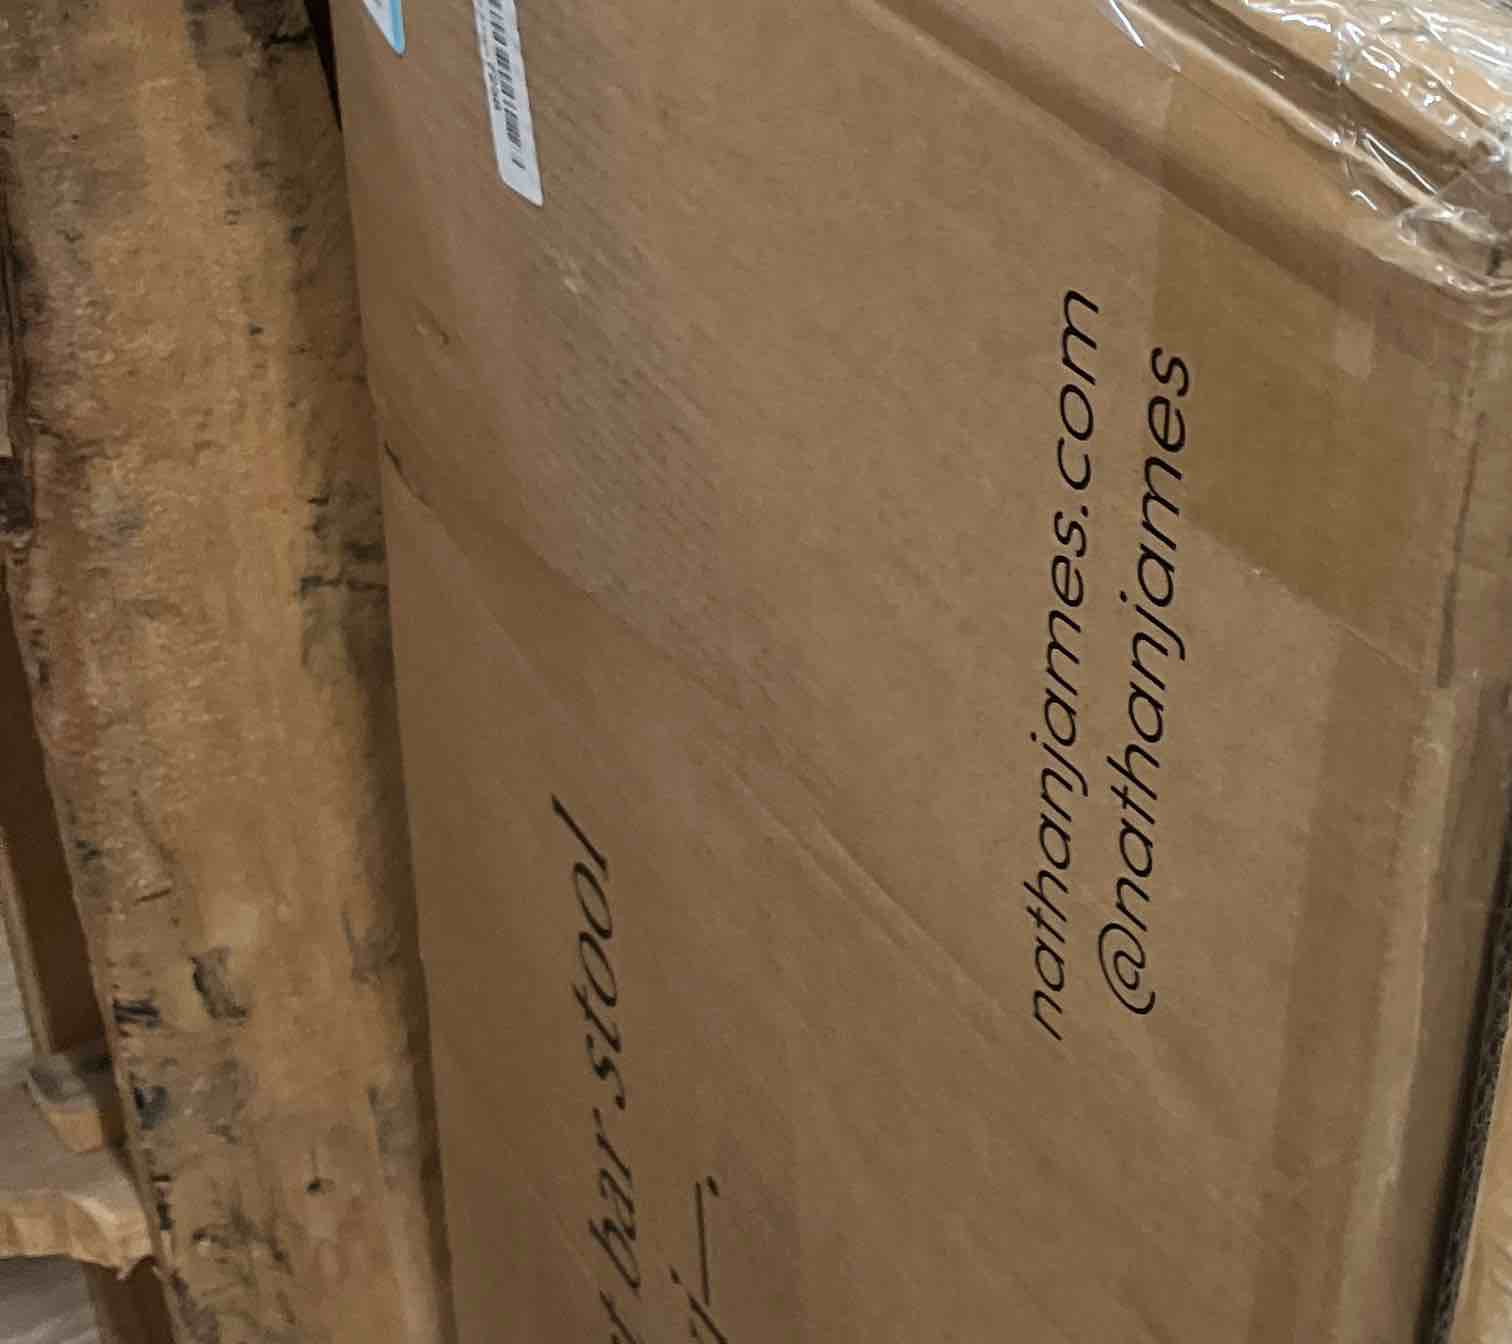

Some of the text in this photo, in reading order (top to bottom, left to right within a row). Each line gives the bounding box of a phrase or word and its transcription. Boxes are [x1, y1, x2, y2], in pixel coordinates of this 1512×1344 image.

[1023, 288, 1100, 1040] nathanjames.com
[1099, 346, 1190, 1015] @nathanjames
[550, 792, 627, 1110] stool
[588, 1107, 642, 1290] bar
